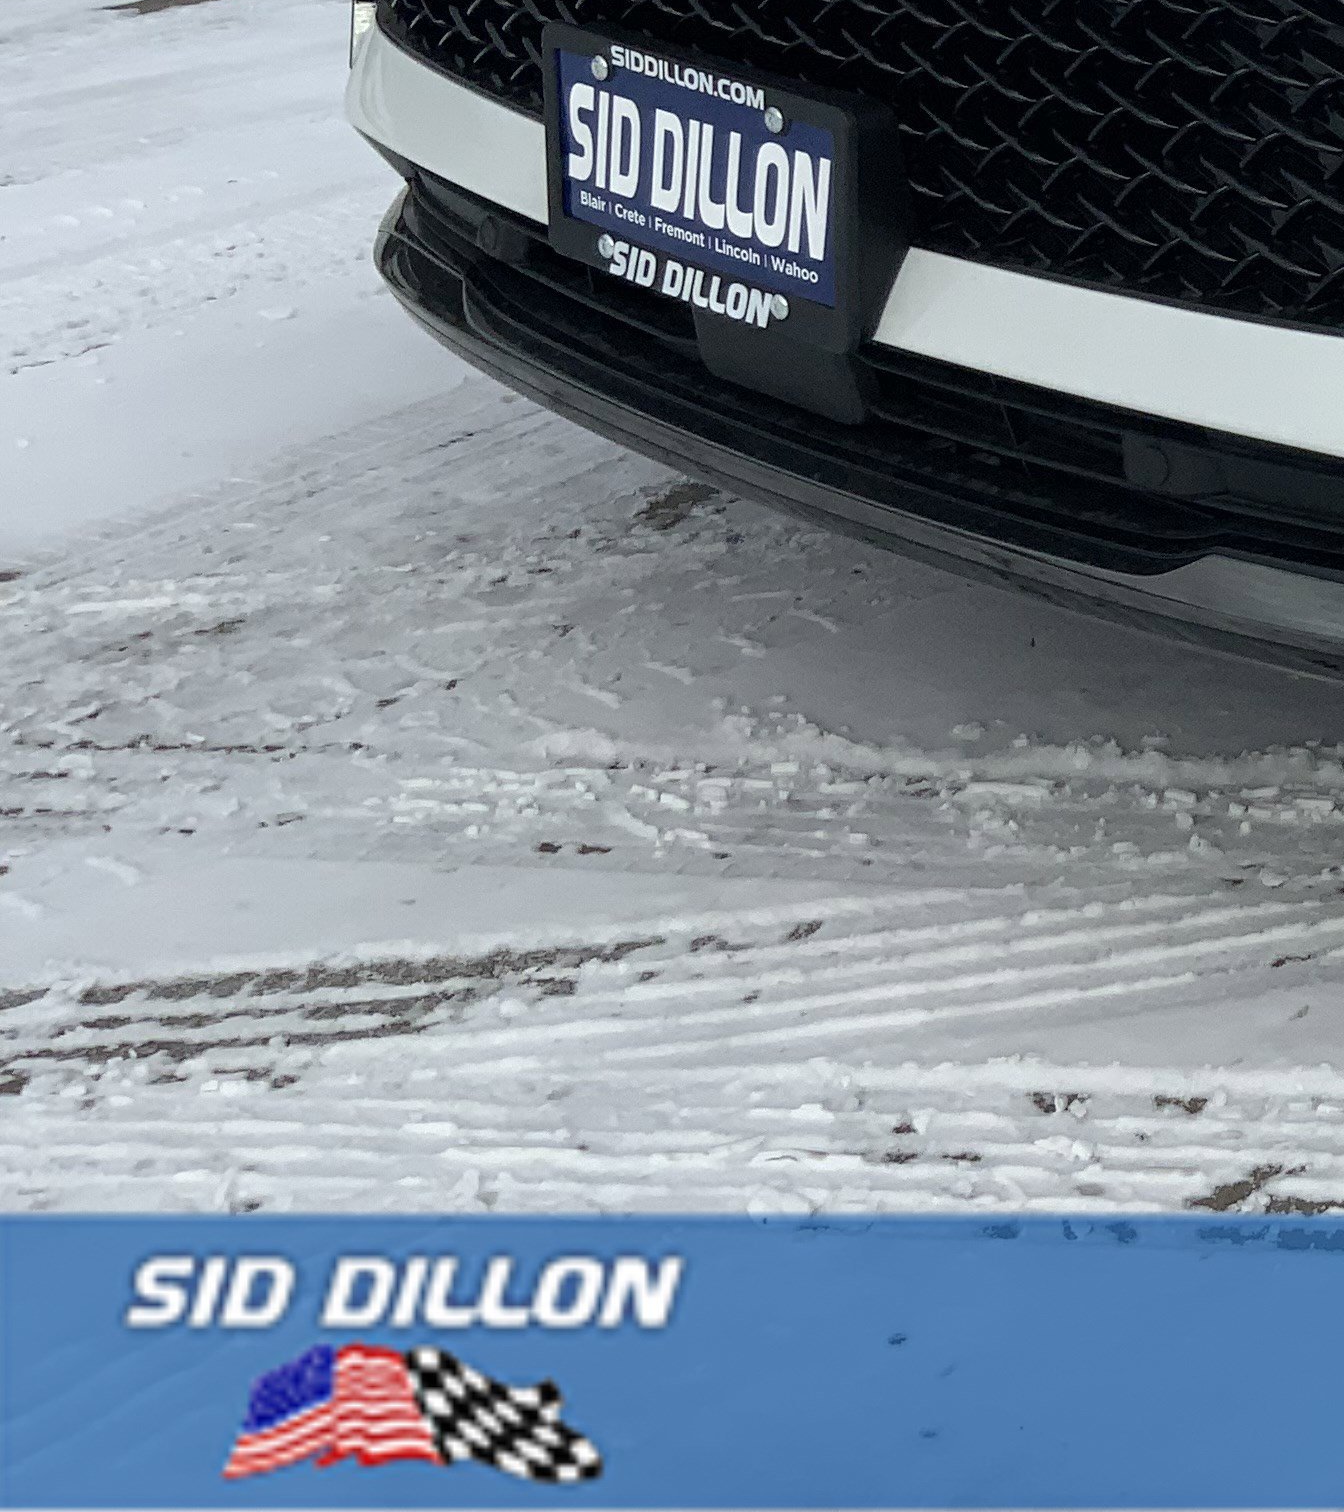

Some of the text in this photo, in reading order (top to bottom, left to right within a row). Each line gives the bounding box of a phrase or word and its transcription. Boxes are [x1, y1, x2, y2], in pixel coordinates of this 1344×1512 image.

[610, 45, 765, 110] SIDDILLON.COM
[568, 82, 831, 261] SID DILLON
[580, 190, 819, 284] Blair Crete Fremont Lincoln Wahoo
[609, 239, 774, 329] SID DILLON
